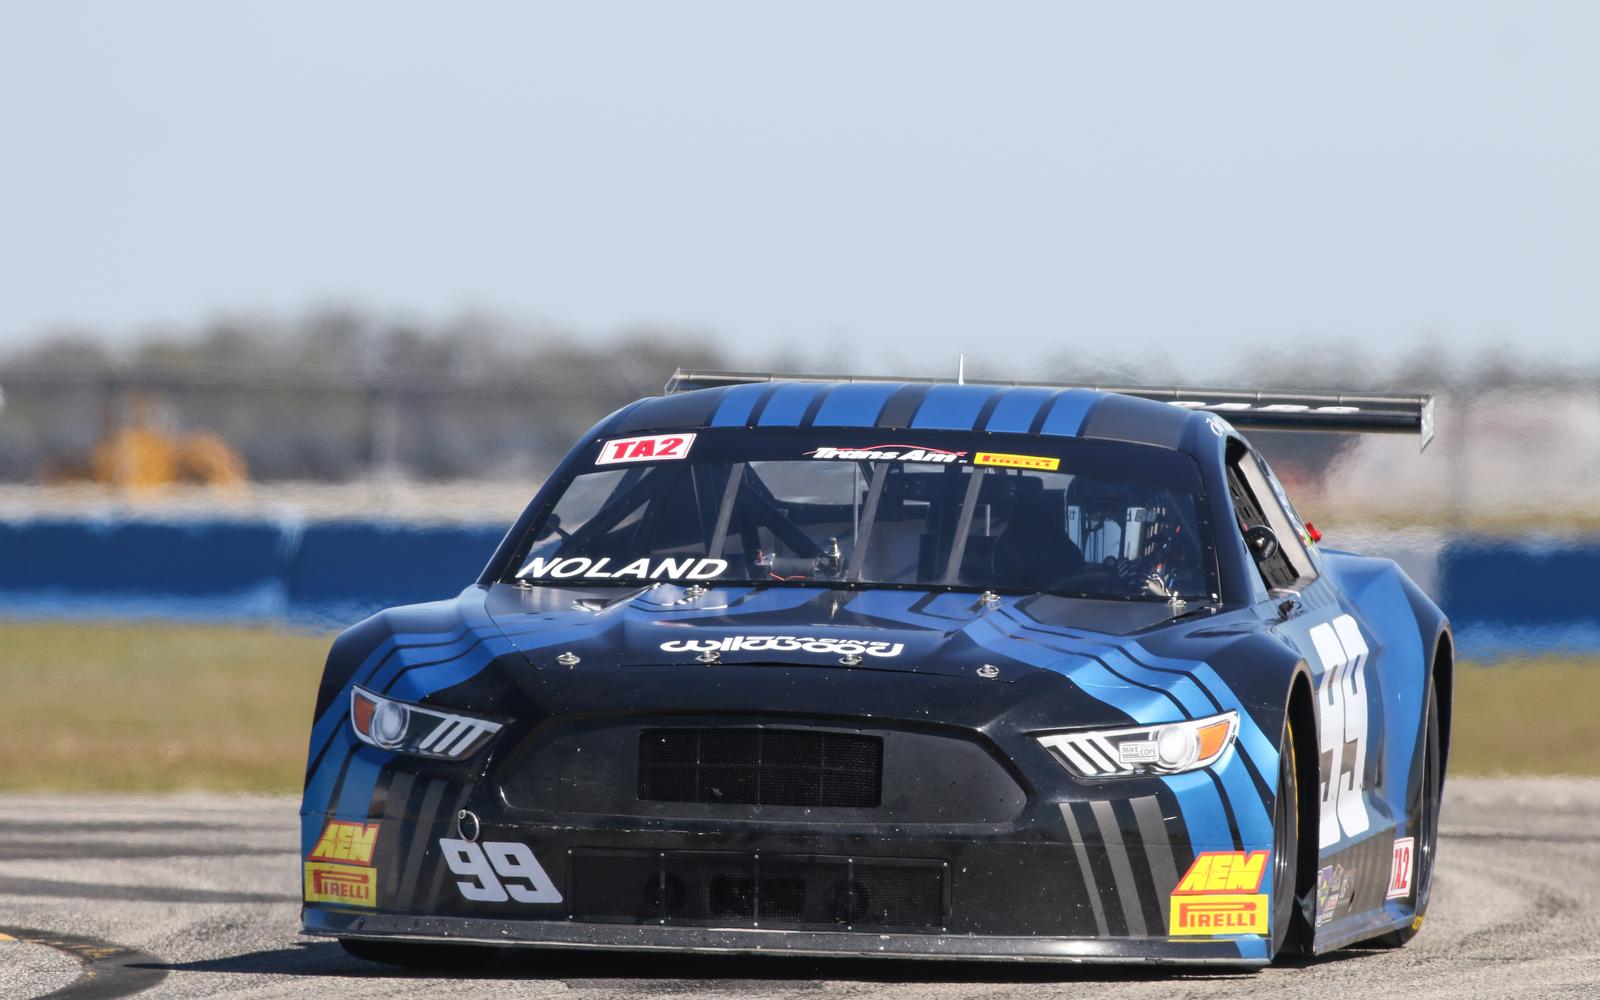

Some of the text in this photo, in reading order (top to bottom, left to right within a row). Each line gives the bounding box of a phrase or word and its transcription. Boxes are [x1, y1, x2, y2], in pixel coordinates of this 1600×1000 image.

[613, 438, 684, 459] TA2
[812, 447, 957, 463] Trans Am
[515, 557, 729, 580] NOLAND
[311, 823, 377, 862] AEM
[439, 838, 563, 903] 99
[1178, 853, 1266, 891] AEM
[1391, 847, 1409, 890] TA2
[313, 869, 369, 900] PIRELLI
[1179, 902, 1257, 928] PIRELLI
